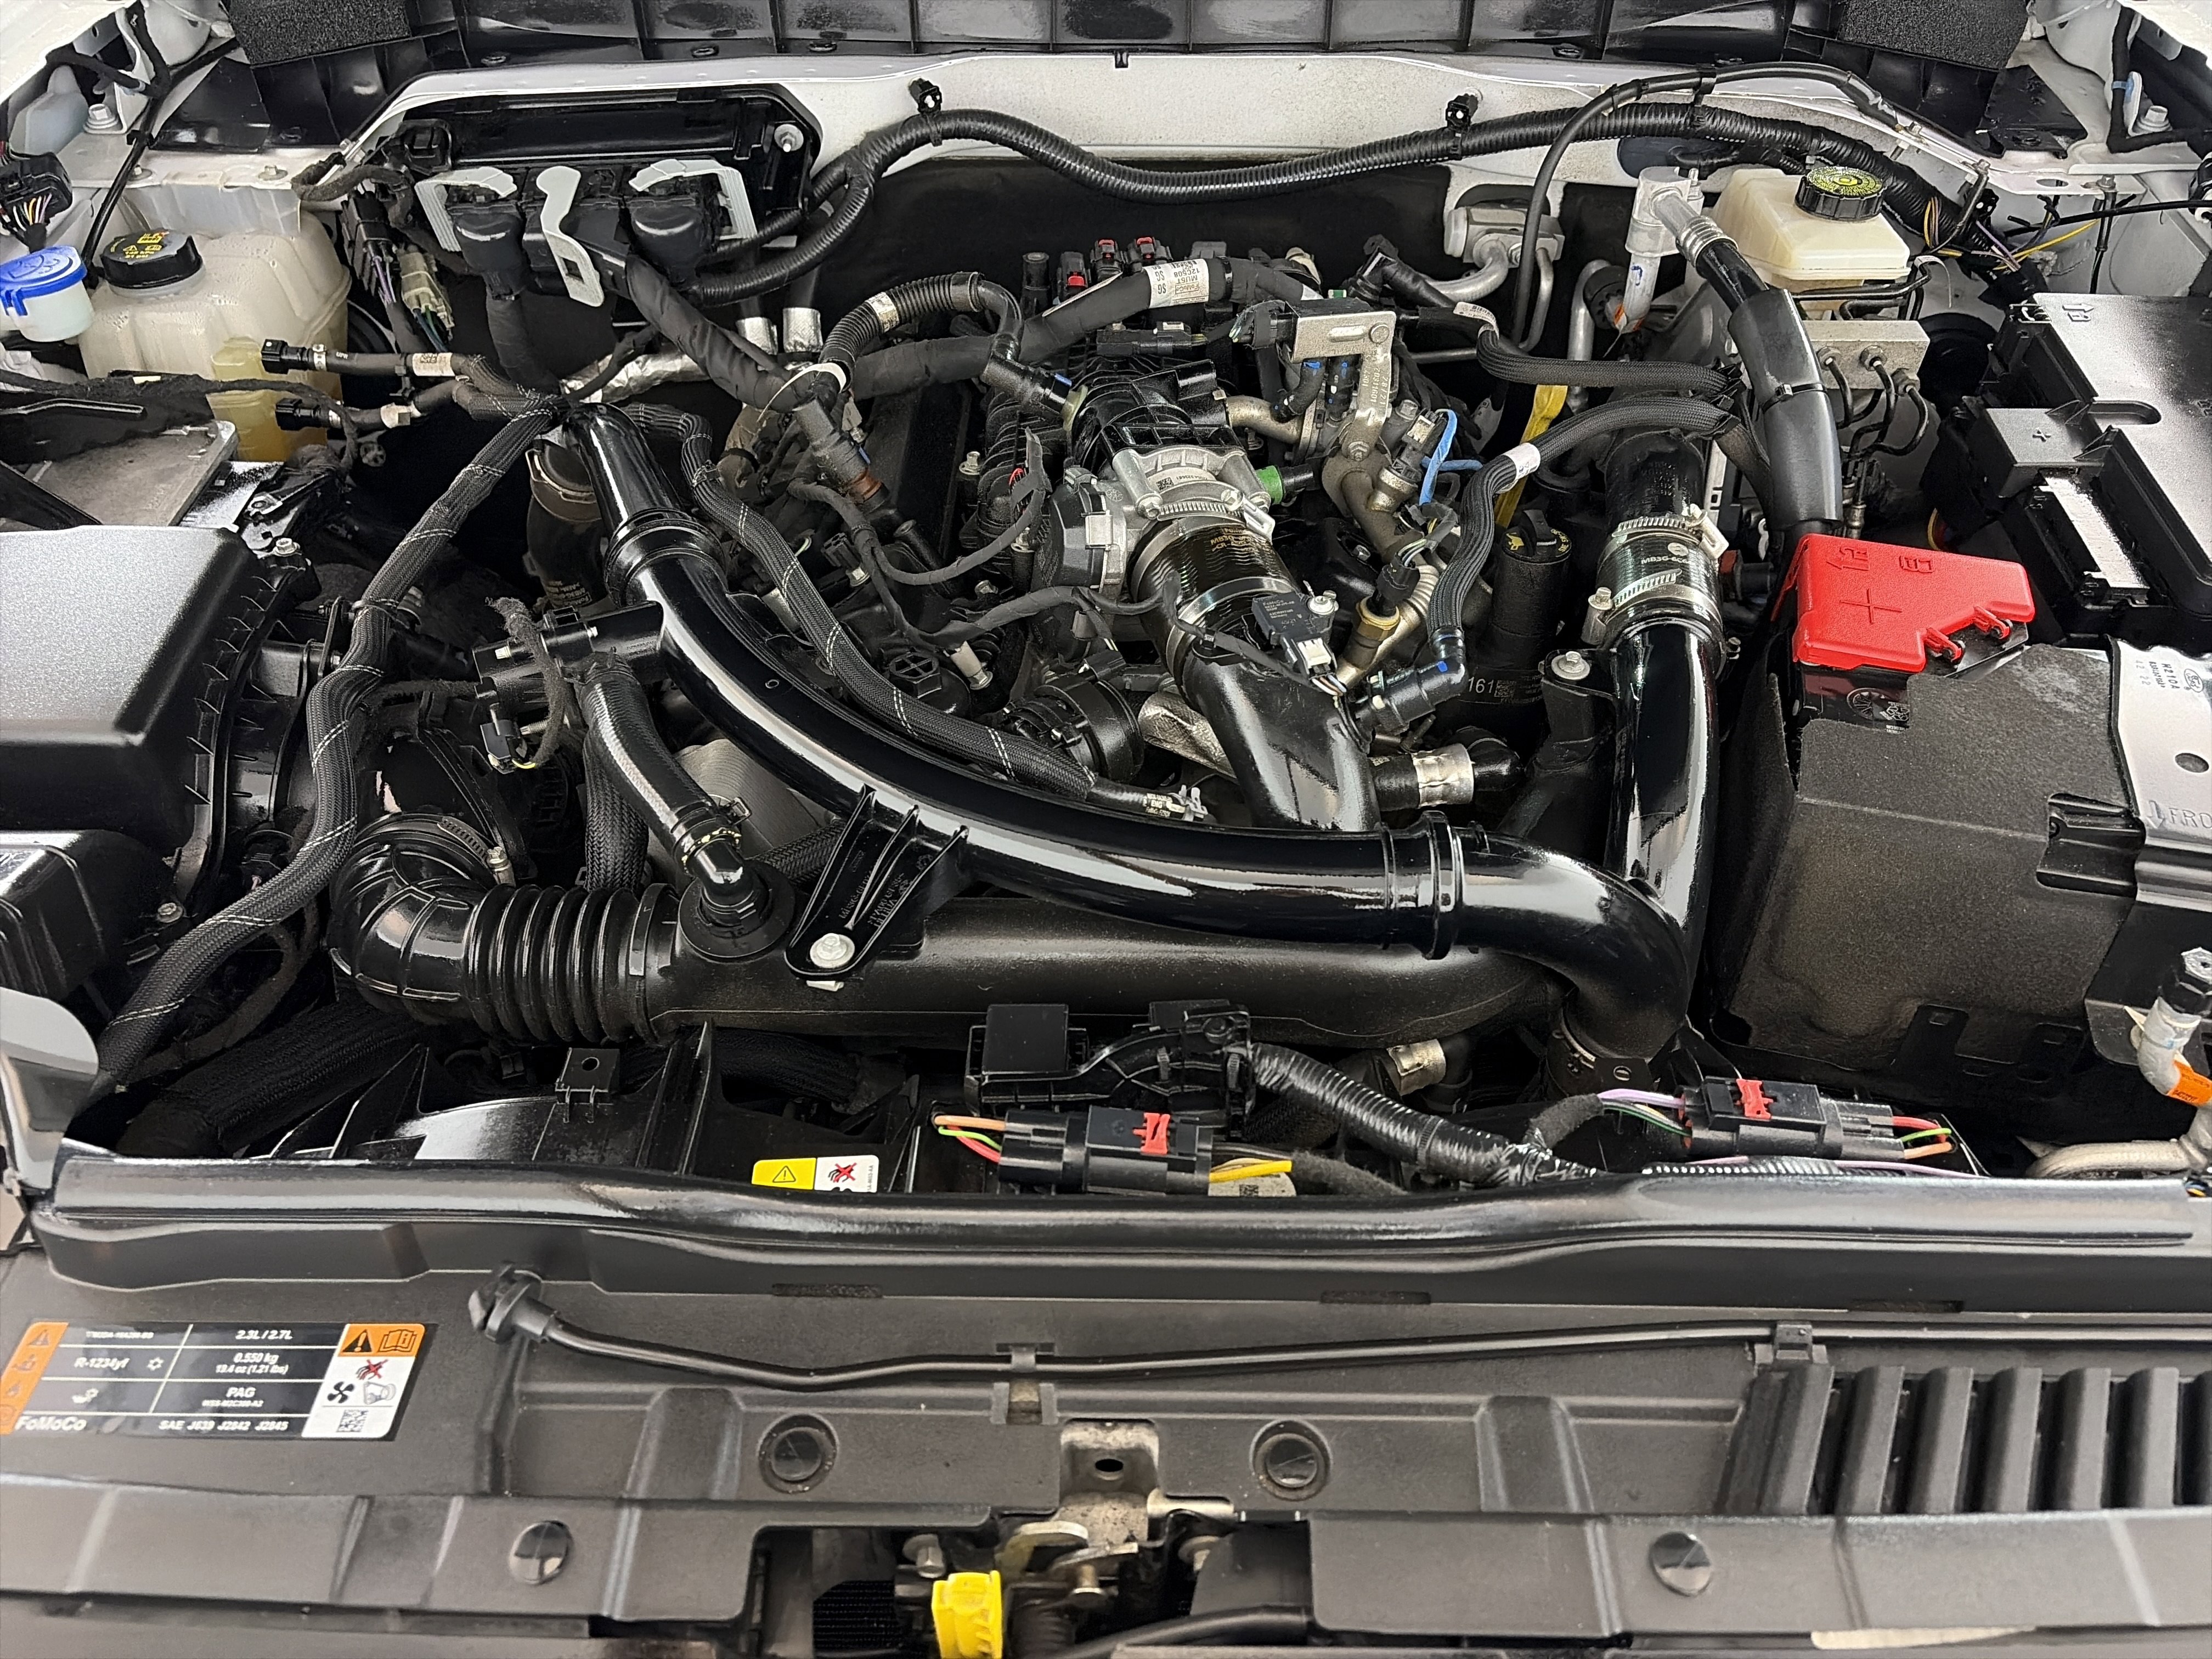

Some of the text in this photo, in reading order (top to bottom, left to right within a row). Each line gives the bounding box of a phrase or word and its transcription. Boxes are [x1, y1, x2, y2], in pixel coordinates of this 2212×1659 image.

[1155, 270, 1165, 281] SG
[1173, 268, 1200, 278] 12C508
[1158, 283, 1166, 295] SG
[1468, 676, 1494, 693] 161
[235, 1330, 261, 1340] 2.3L
[268, 1330, 294, 1340] 2.7L
[74, 1357, 130, 1370] R-1234yf
[233, 1353, 279, 1365] 0.550 kg
[225, 1387, 257, 1398] PAG
[14, 1415, 87, 1431] FoMoCo
[159, 1420, 184, 1430] SAE
